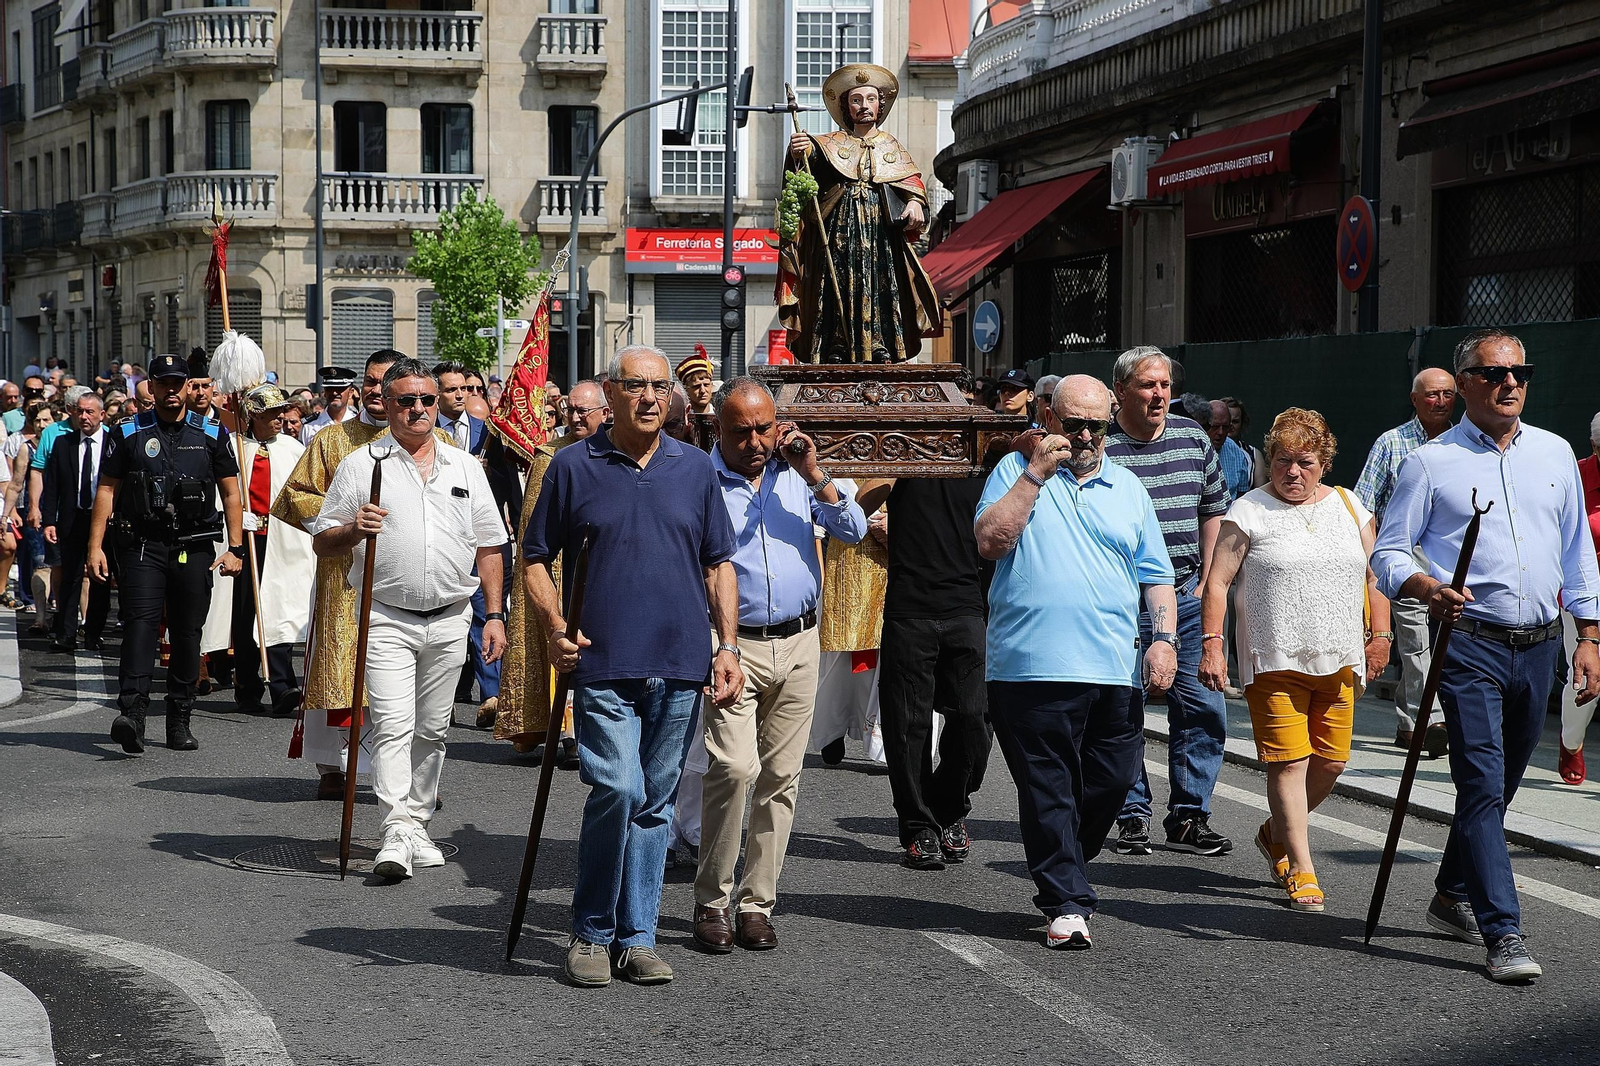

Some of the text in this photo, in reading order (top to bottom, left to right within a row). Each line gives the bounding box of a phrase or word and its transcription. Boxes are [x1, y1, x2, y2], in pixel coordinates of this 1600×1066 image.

[1163, 152, 1268, 186] LA VIDA ES DEMASIADO CORTA PARA VESTIR TRISTE
[656, 237, 763, 251] Ferretería Sgado
[513, 387, 538, 432] CIDADE
